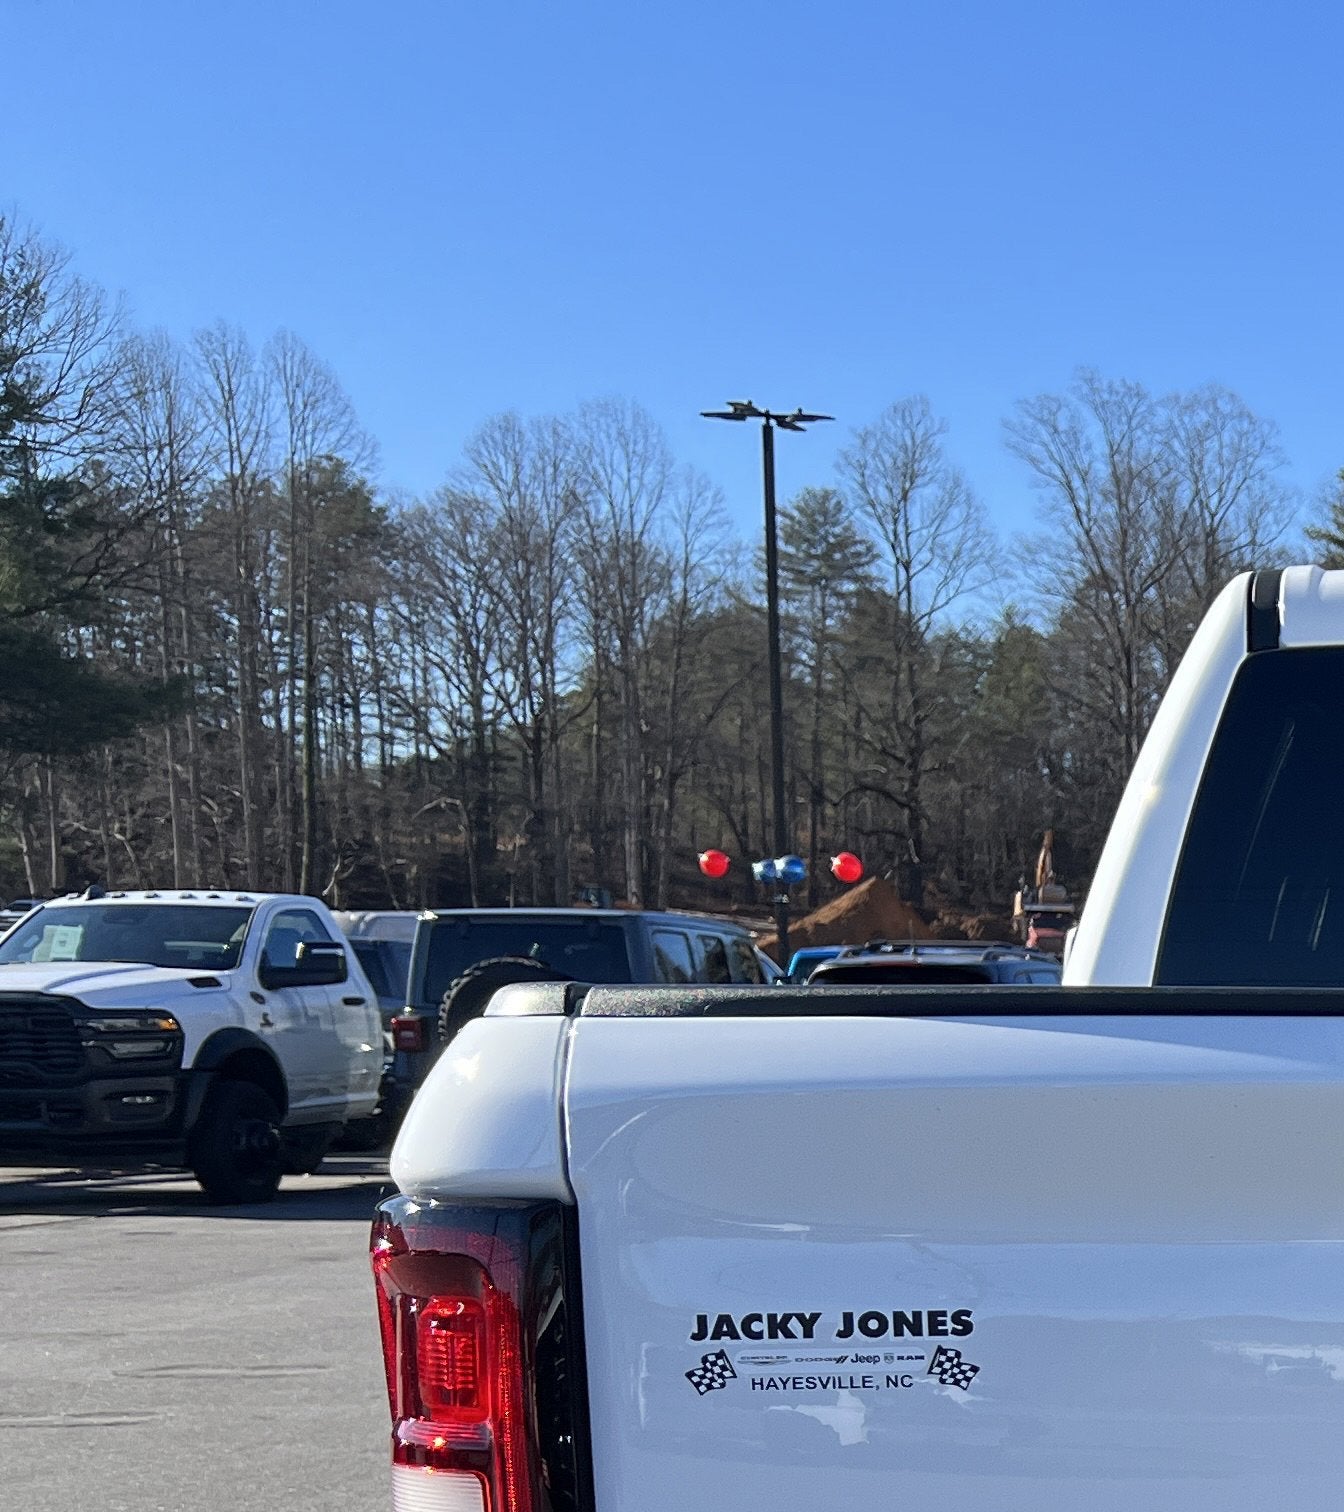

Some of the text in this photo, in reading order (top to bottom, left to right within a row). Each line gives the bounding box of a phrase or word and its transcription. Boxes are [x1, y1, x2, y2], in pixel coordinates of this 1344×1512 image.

[689, 1308, 975, 1341] JACKY JONES
[851, 1353, 881, 1364] Jeep
[751, 1374, 914, 1391] HAYESVILLE, NC
